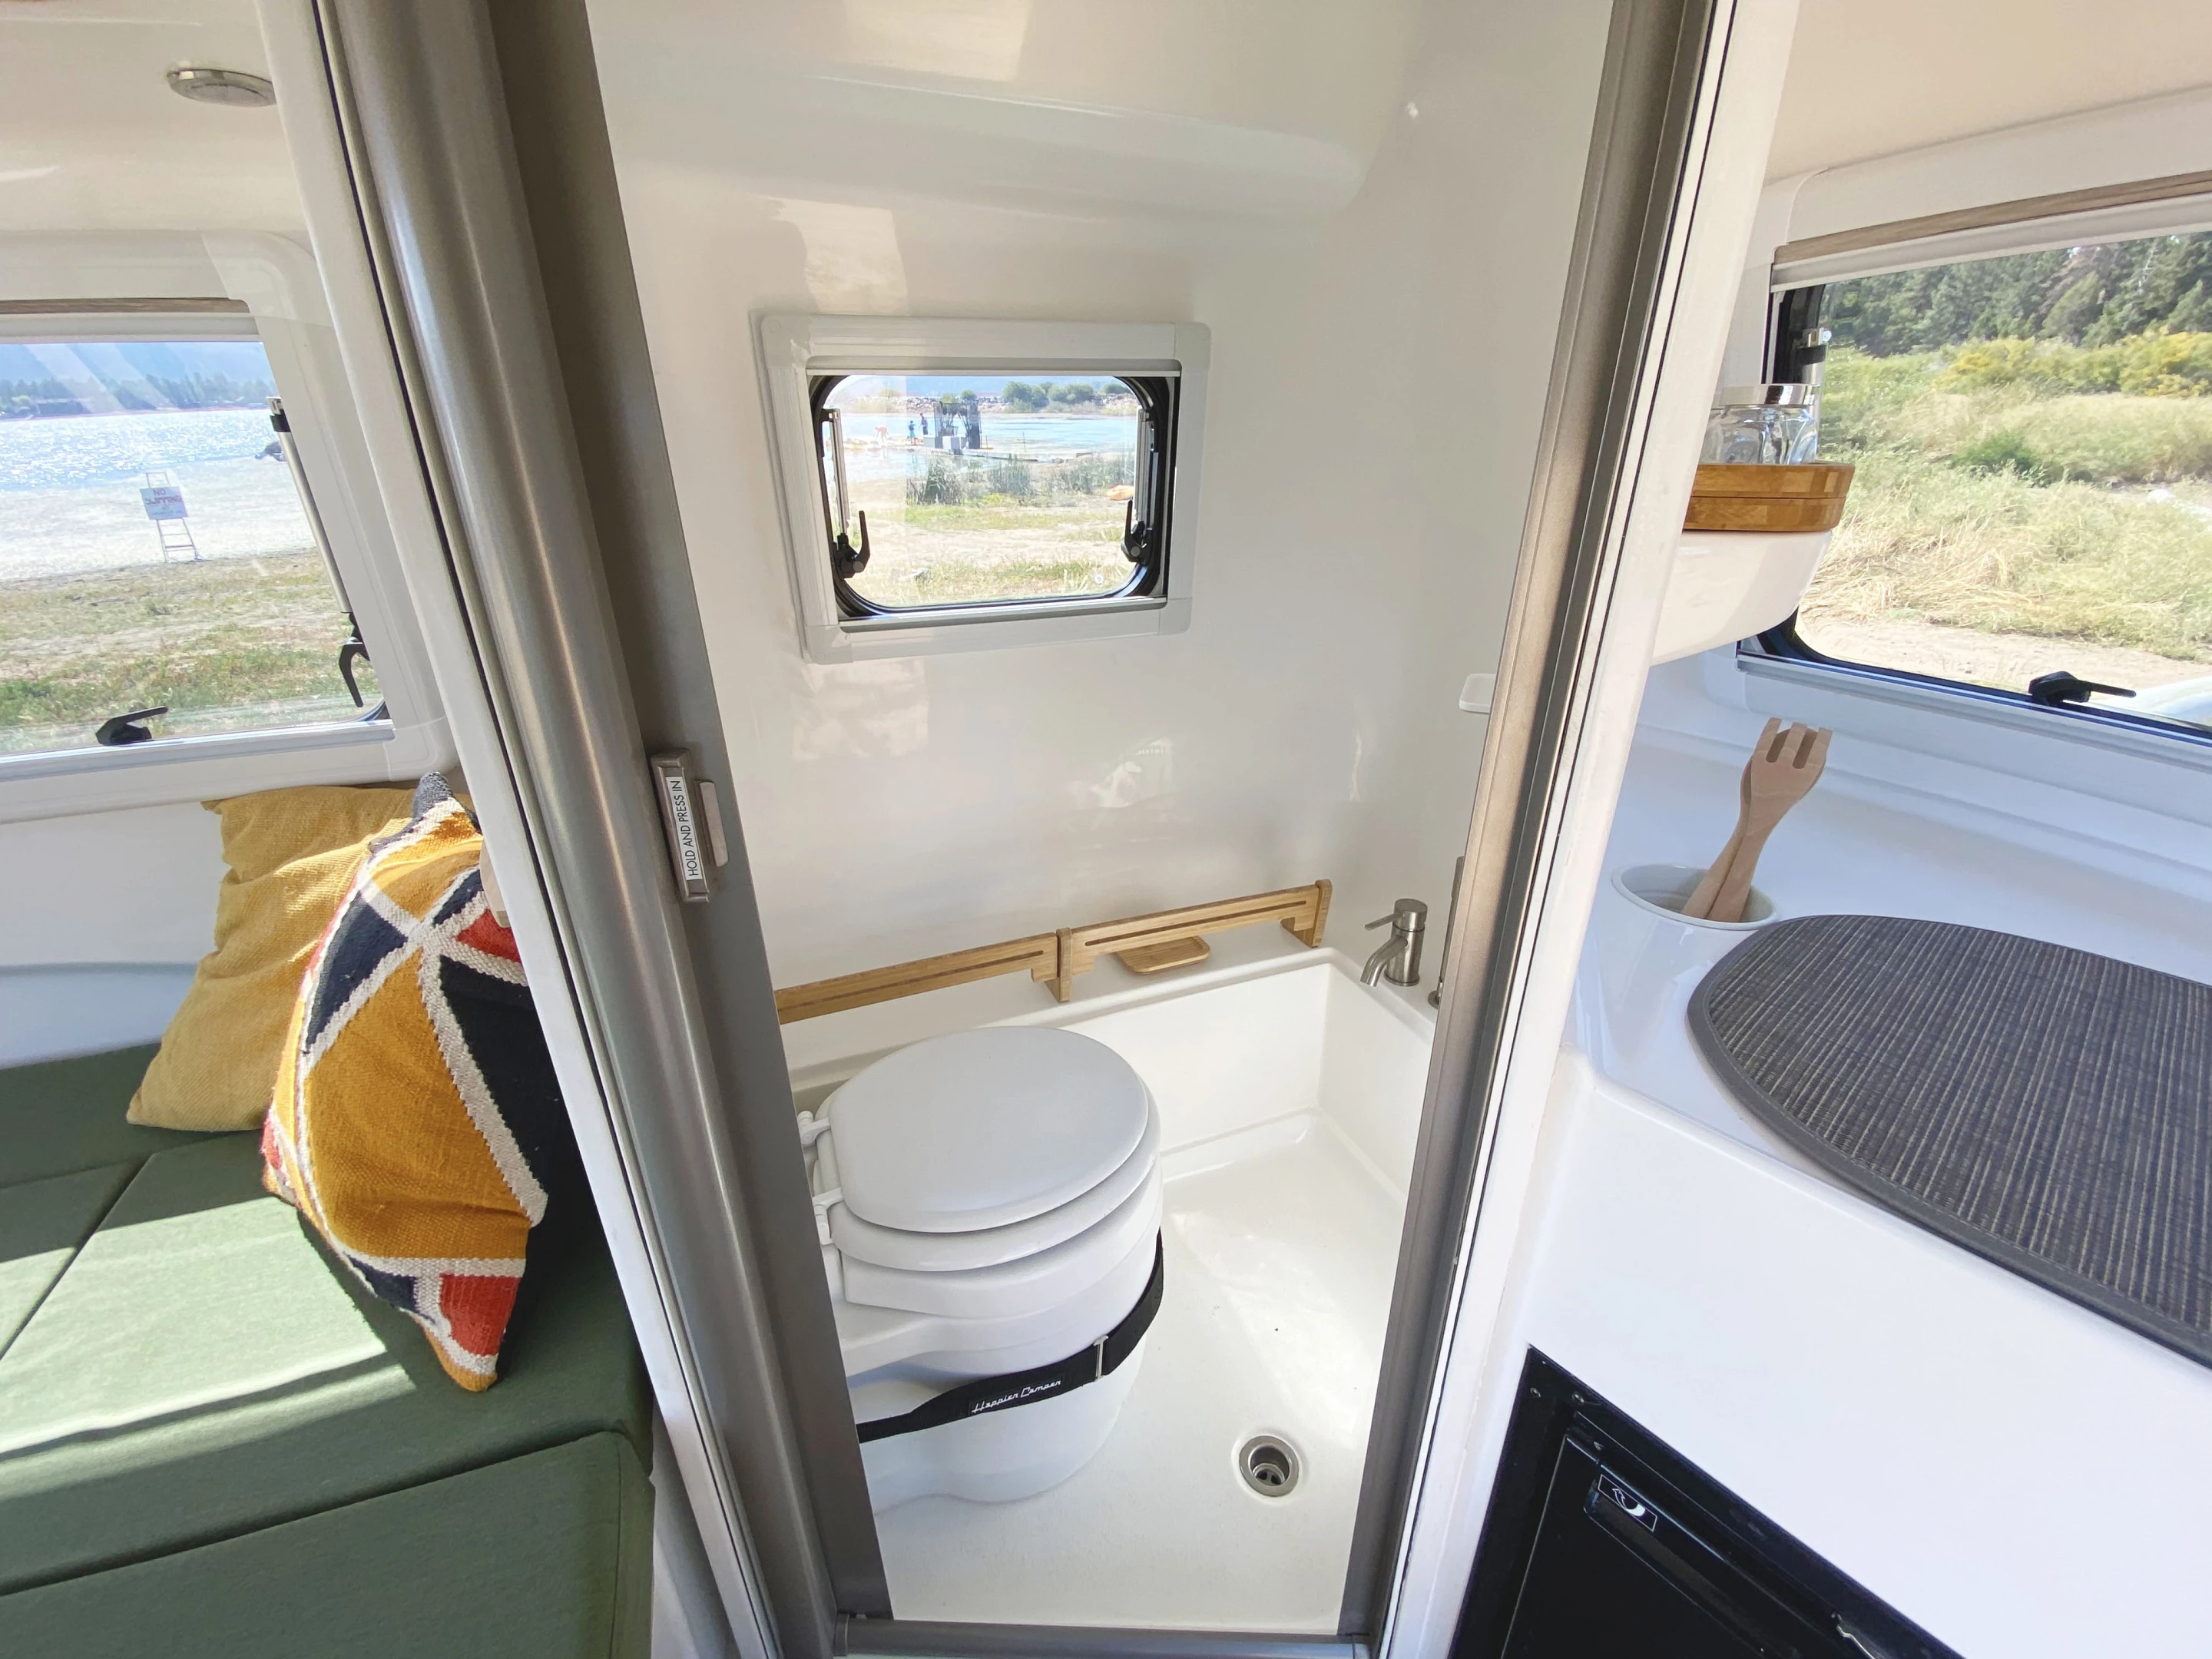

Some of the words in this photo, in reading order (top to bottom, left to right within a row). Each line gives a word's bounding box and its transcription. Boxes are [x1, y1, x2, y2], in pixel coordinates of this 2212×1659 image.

[670, 780, 683, 792] IN
[674, 795, 690, 823] PRESS
[680, 825, 694, 847] AND
[684, 849, 699, 876] HOLD
[971, 1392, 1019, 1414] Happier
[1020, 1380, 1061, 1398] Camper
